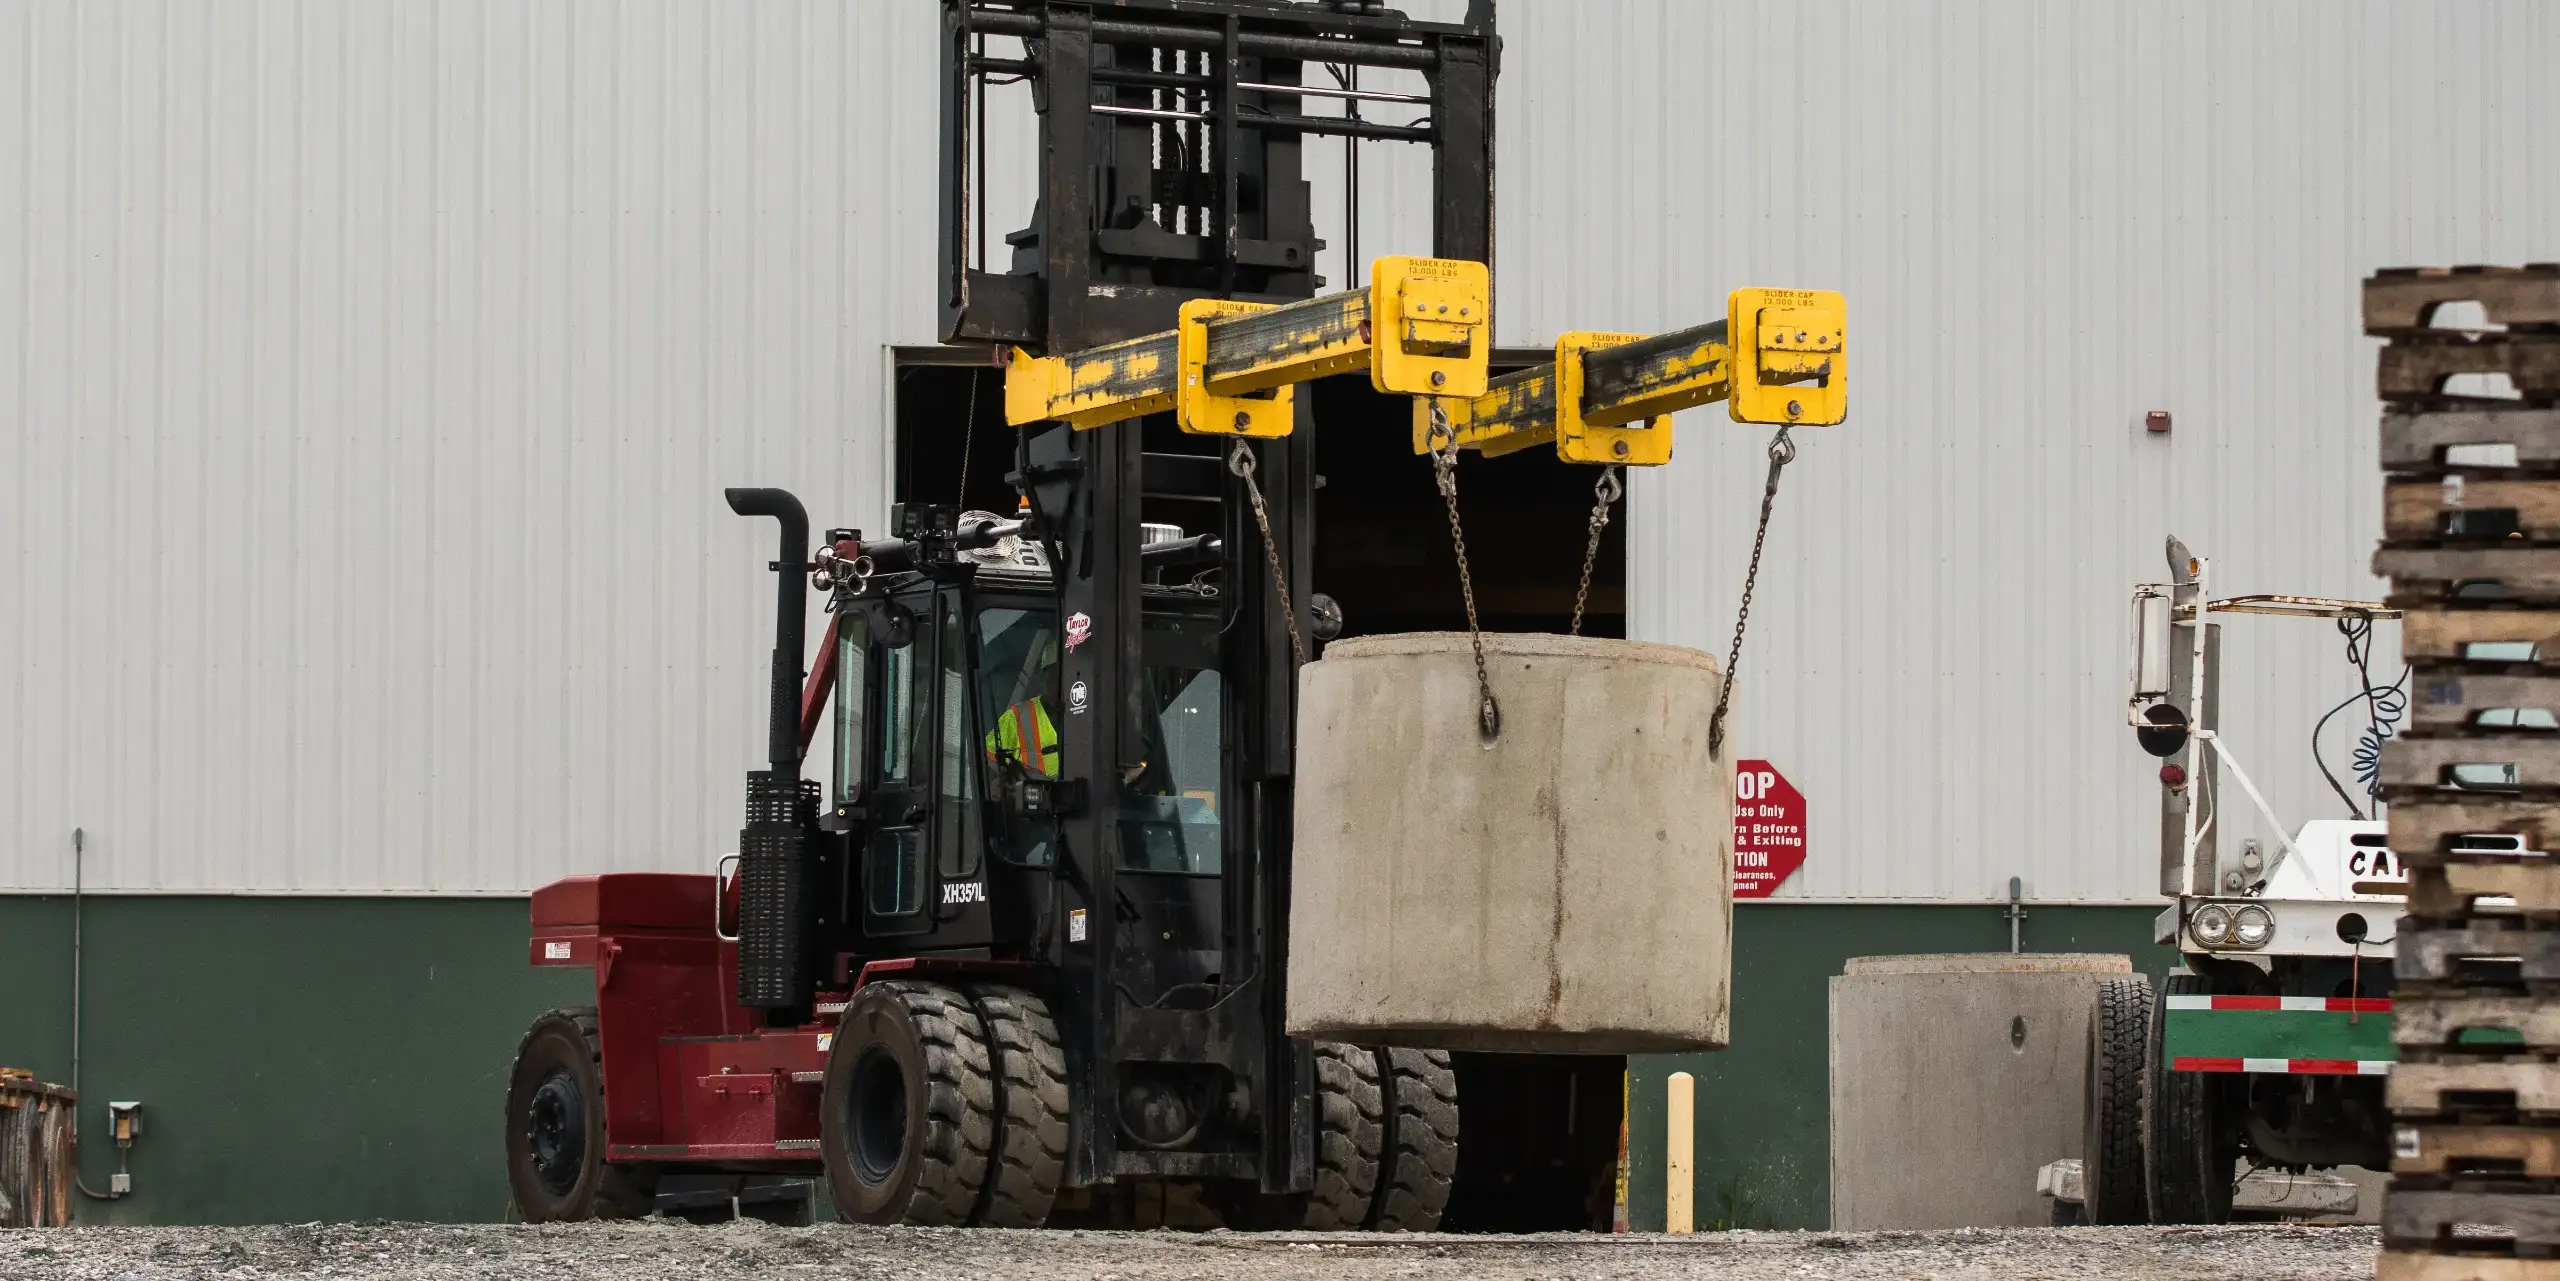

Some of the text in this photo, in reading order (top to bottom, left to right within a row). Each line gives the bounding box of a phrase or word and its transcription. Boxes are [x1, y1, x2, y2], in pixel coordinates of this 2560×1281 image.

[1408, 259, 1458, 269] SLIDER CAP
[1442, 269, 1458, 277] LBS
[1764, 290, 1814, 299] SLIDER CAP
[1216, 302, 1245, 312] SLIDER
[1797, 299, 1814, 307] LBS
[1592, 333, 1621, 342] SLIDER
[1068, 616, 1089, 631] TAYLOR
[1737, 771, 1775, 800] OP
[1759, 804, 1784, 819] Only
[1753, 823, 1798, 834] Before
[1737, 835, 1802, 847] & Exiting
[1734, 851, 1768, 867] TION
[943, 882, 986, 904] XH350L
